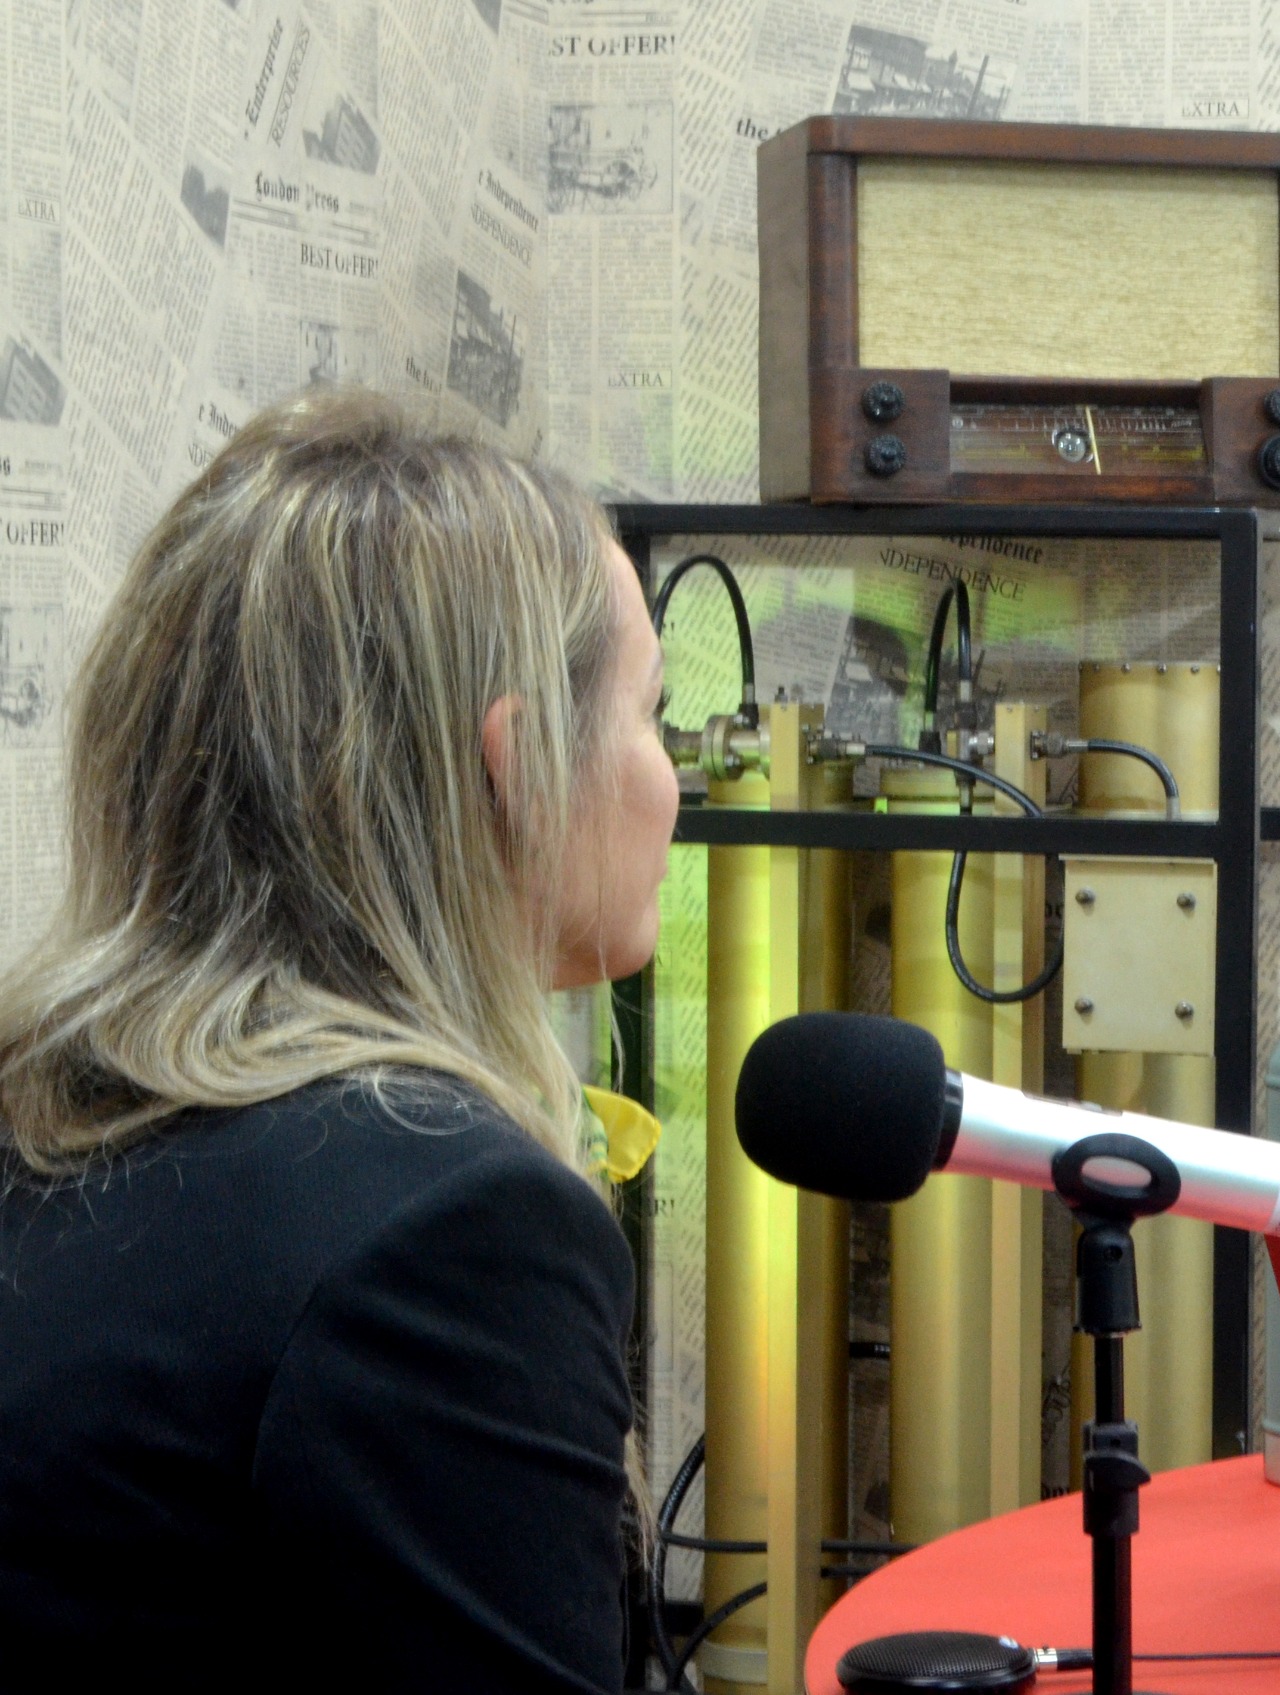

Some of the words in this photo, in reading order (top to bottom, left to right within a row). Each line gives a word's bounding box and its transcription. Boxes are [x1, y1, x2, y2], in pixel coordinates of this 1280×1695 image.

[588, 34, 675, 57] OFFER!
[736, 118, 768, 141] the
[256, 170, 300, 202] London
[301, 243, 332, 271] BEST
[335, 251, 379, 280] OFFER!
[6, 521, 65, 546] OFFER!
